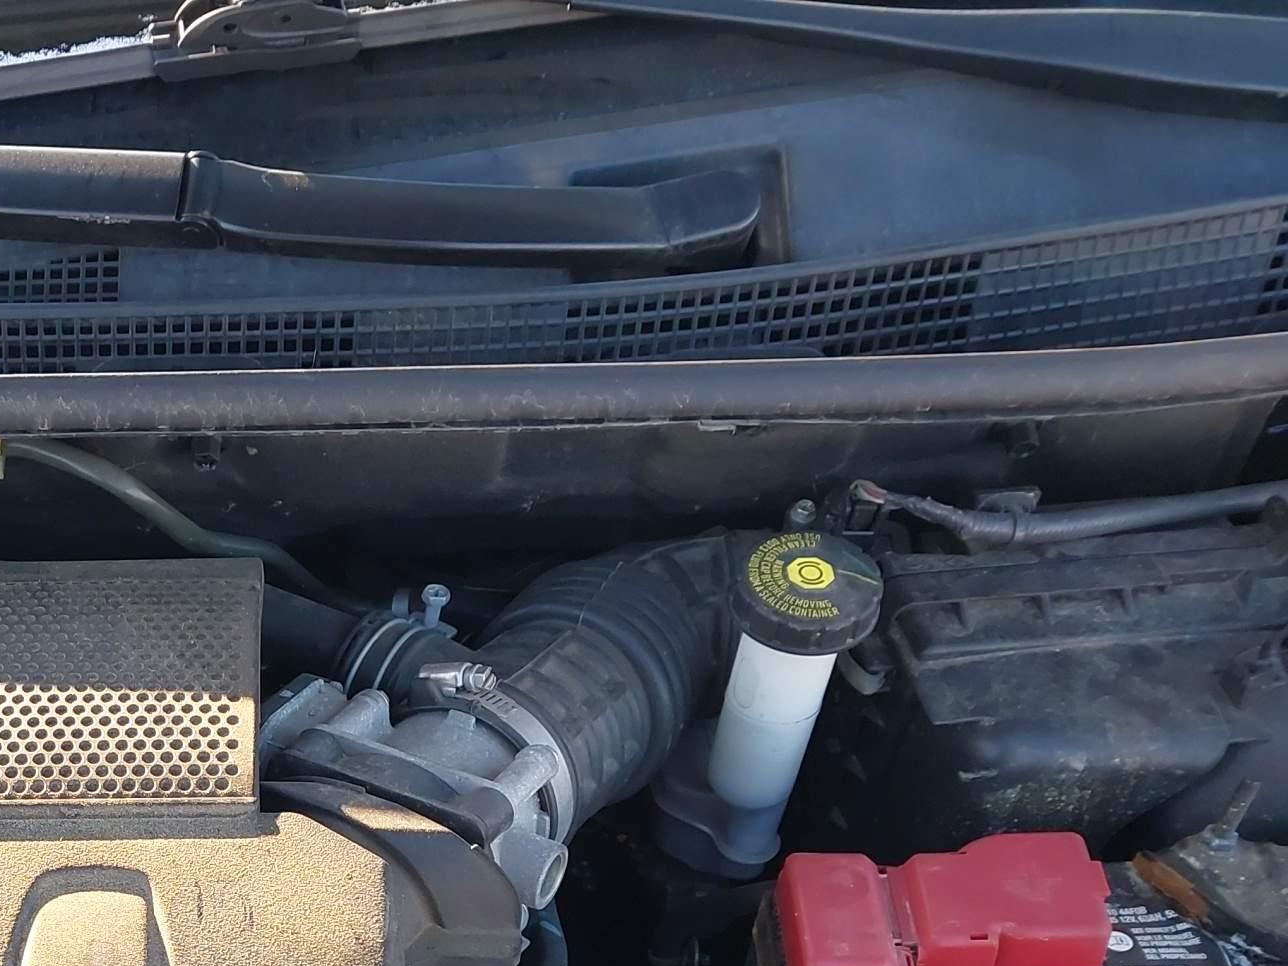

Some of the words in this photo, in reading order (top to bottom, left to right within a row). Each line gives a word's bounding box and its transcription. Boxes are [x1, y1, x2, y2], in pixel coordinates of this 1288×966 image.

[759, 590, 789, 611] SEALED
[789, 604, 840, 618] CONTAINER
[760, 574, 785, 598] BEFORE
[784, 594, 832, 609] REMOVING
